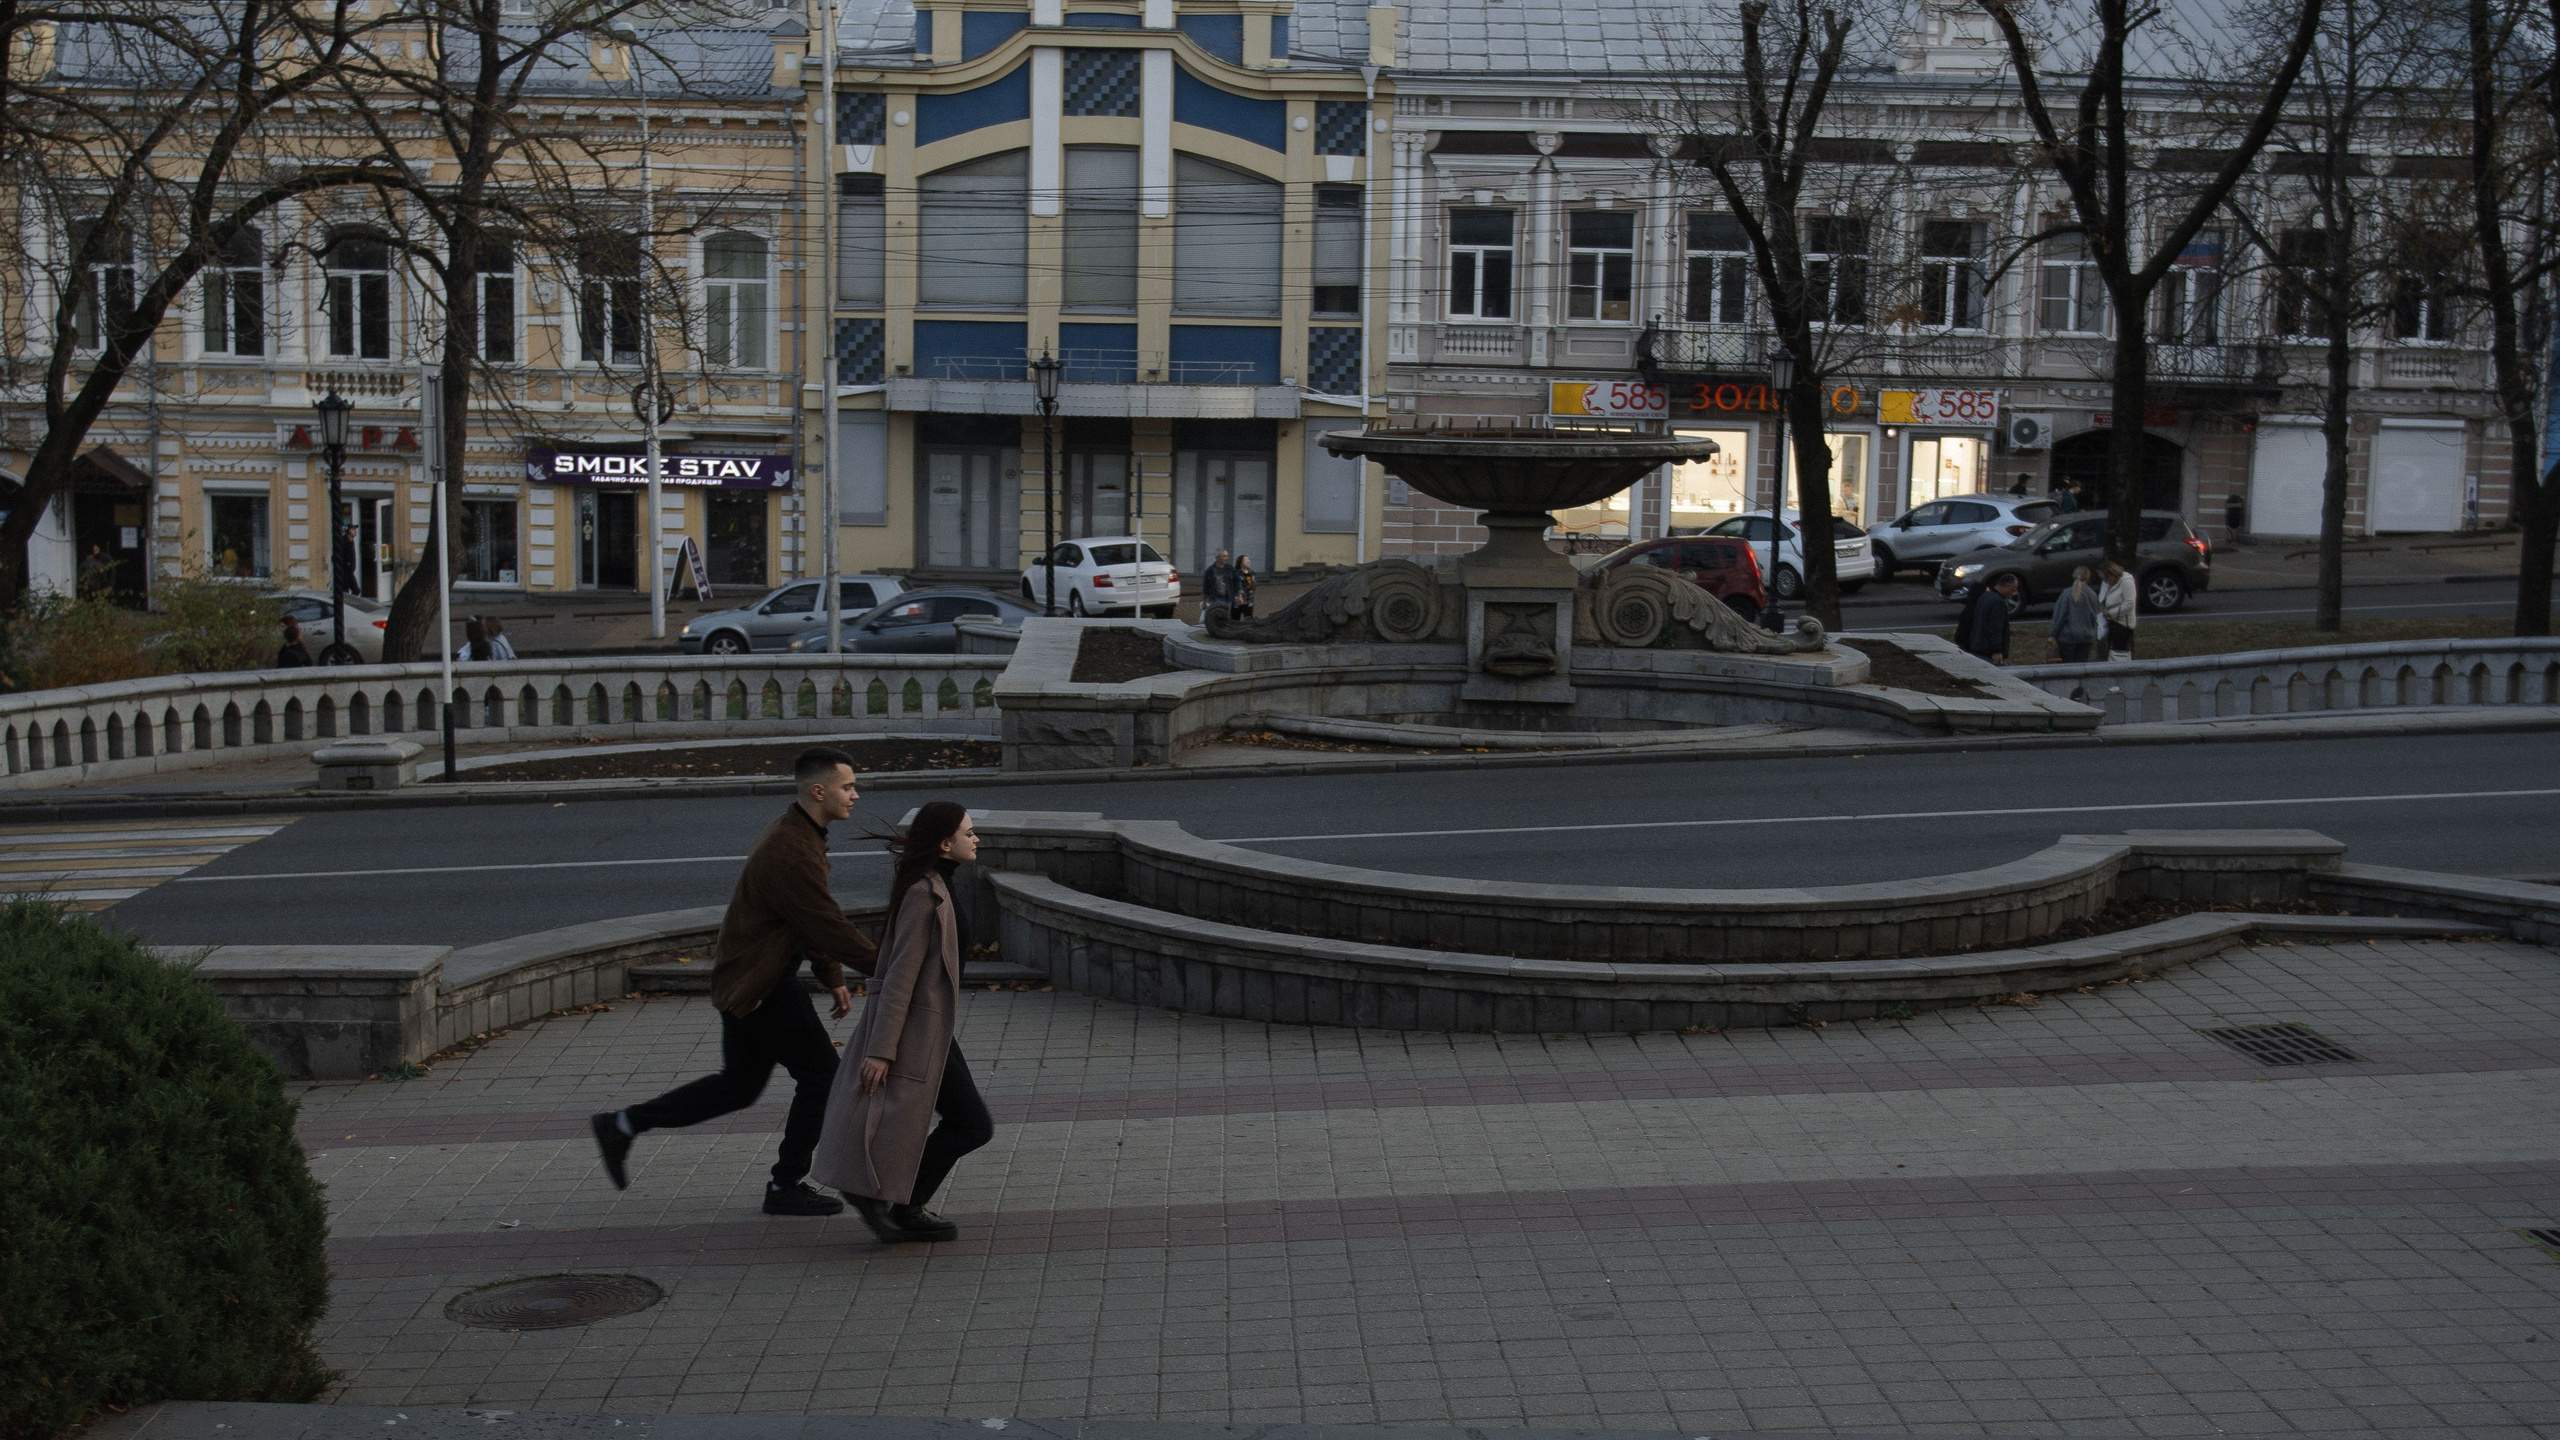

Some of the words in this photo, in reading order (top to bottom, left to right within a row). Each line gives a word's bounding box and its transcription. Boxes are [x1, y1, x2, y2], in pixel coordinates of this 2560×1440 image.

[1609, 382, 1666, 411] 585
[1689, 382, 1859, 414] ЗОЛО
[1938, 391, 1995, 419] 585
[287, 425, 419, 450] АРА
[554, 455, 670, 475] SMOKE
[679, 458, 762, 478] STAV
[675, 477, 723, 486] ПРОДУКЦИЯ
